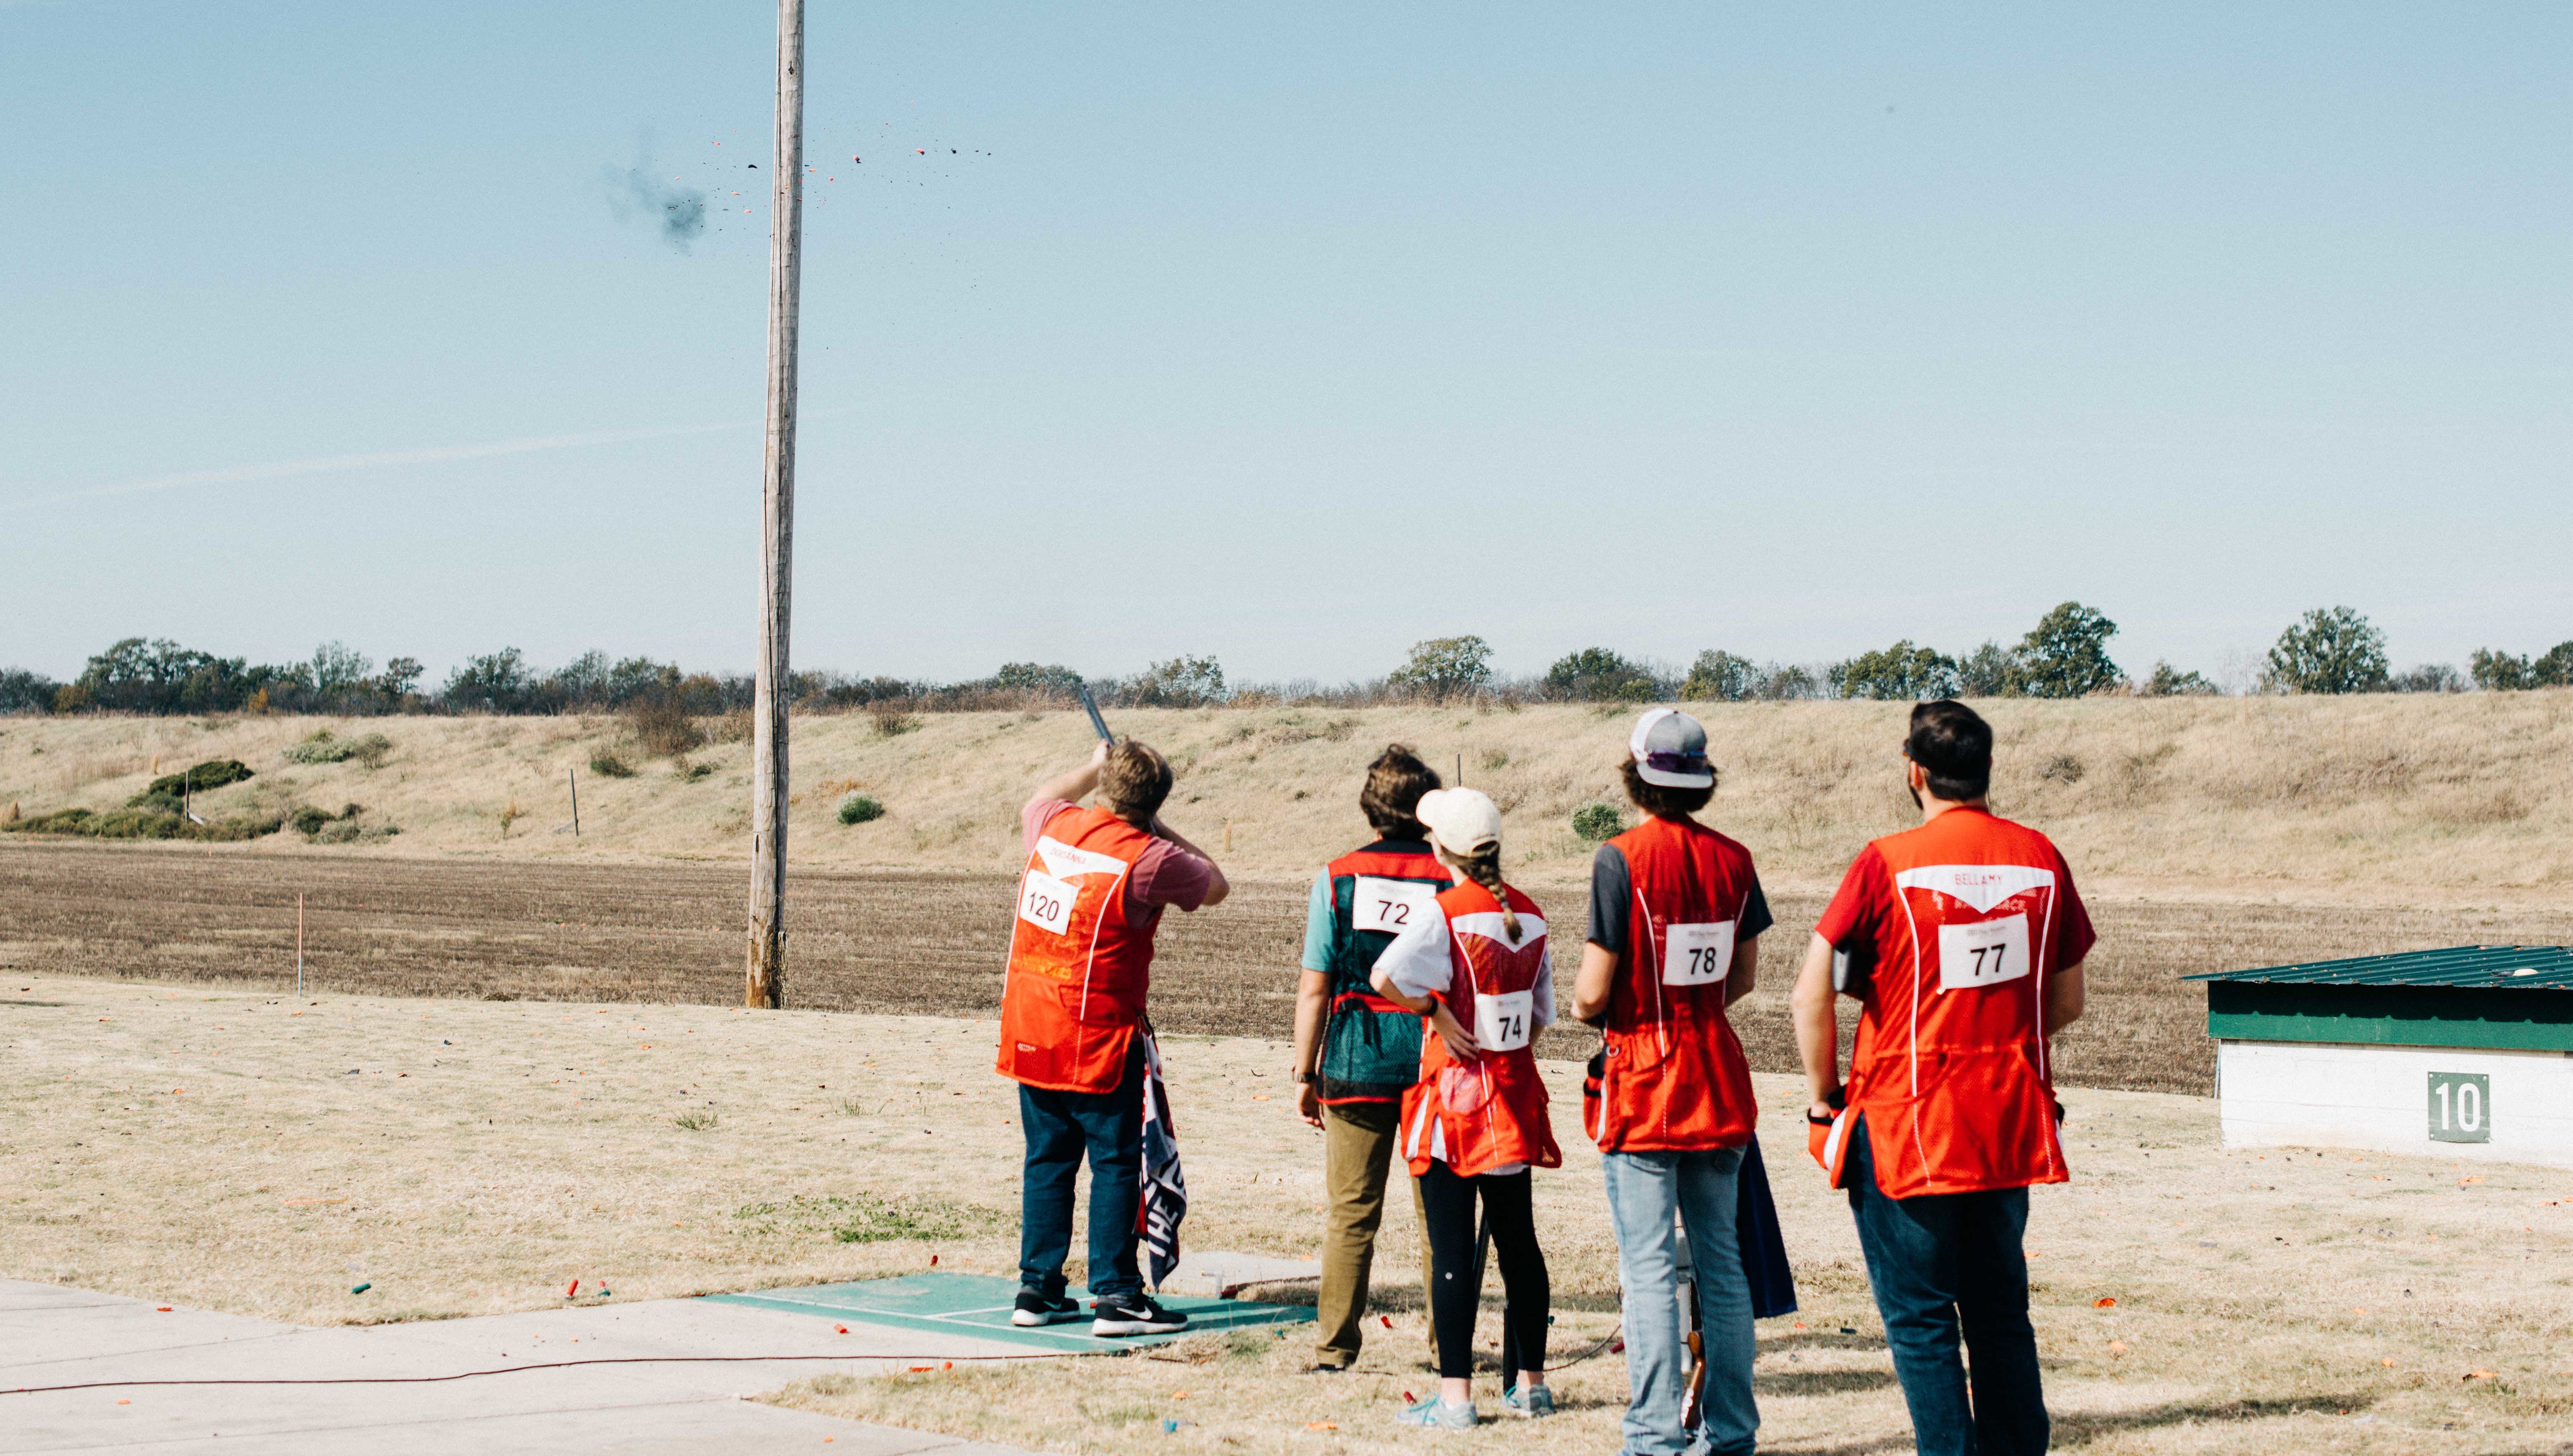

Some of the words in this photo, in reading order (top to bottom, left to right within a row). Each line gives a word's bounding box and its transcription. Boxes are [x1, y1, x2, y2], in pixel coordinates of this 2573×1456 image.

[1031, 892, 1059, 921] 120
[1379, 900, 1410, 925] 72
[1690, 947, 1716, 974] 78
[1970, 943, 2005, 976] 77
[1499, 1014, 1521, 1042] 74
[2436, 1082, 2481, 1132] 10
